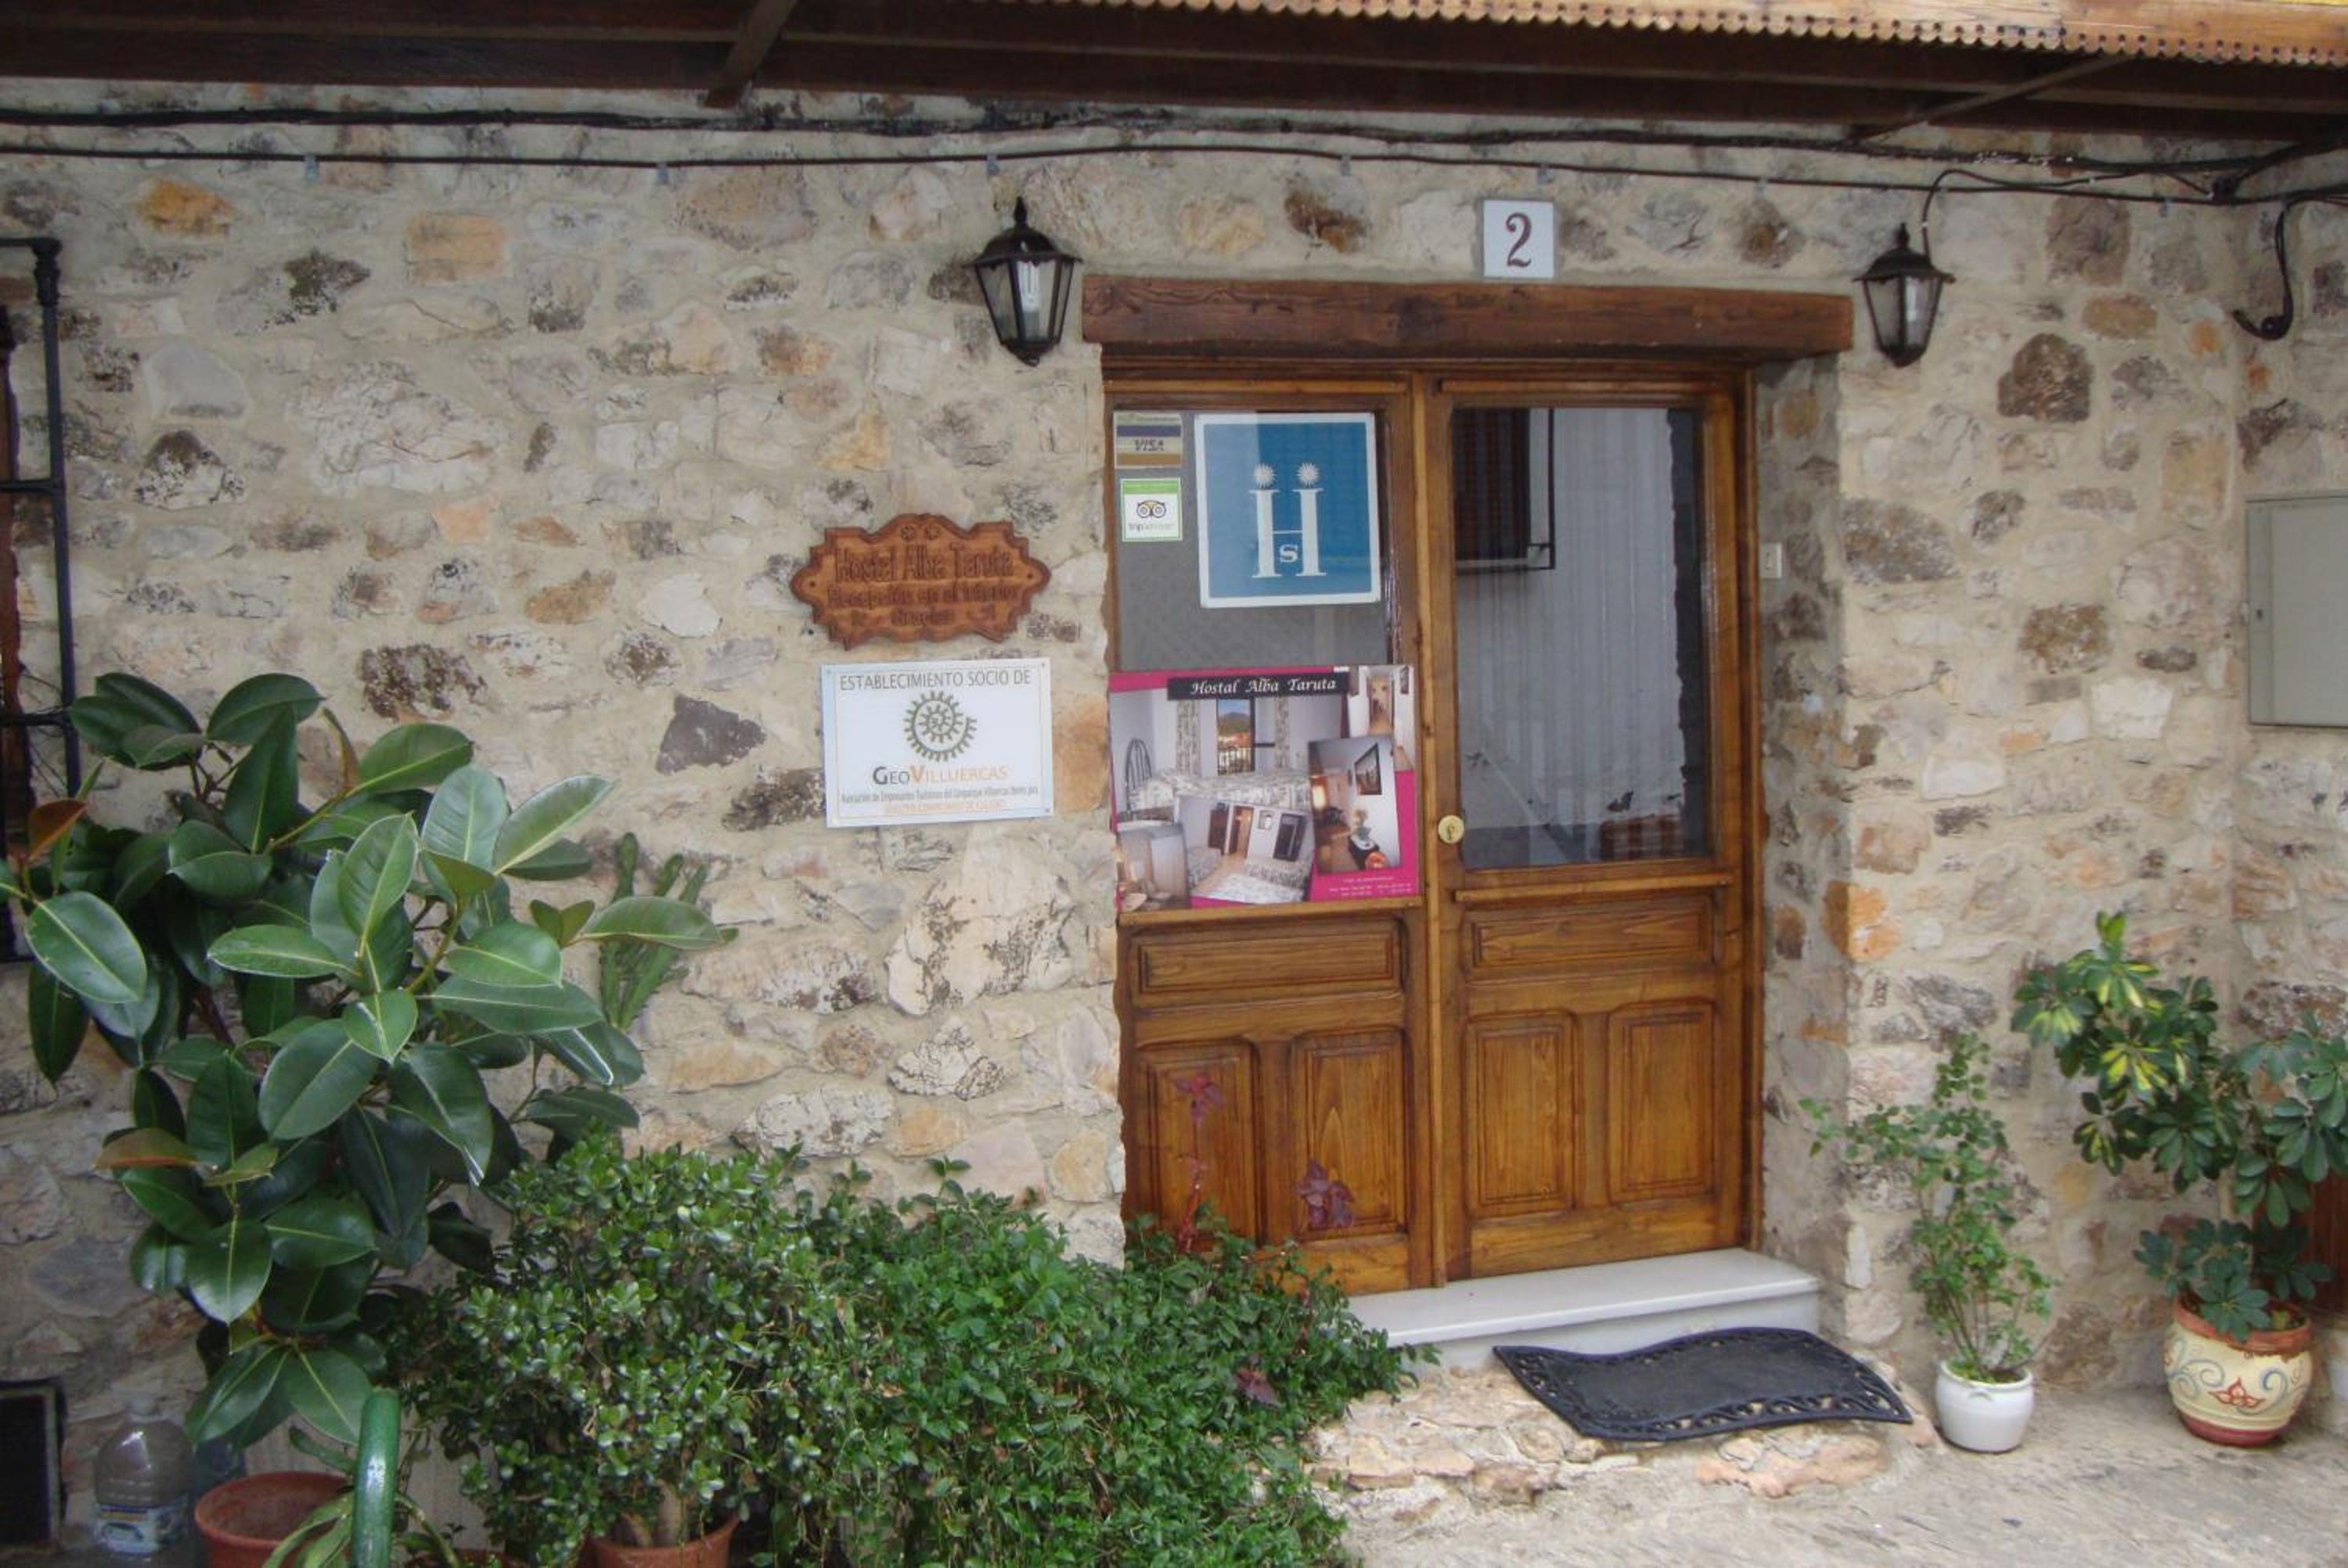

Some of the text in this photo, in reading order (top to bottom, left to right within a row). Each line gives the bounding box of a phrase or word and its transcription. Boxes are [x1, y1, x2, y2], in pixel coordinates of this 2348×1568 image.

[1506, 212, 1532, 268] 2
[1133, 438, 1165, 451] VISA
[834, 542, 1014, 582] Hostal Alba Taruta
[840, 669, 1031, 691] ESTABLECIMIENTO SOCIO DE
[1190, 677, 1338, 695] Hostal Alba Taruta
